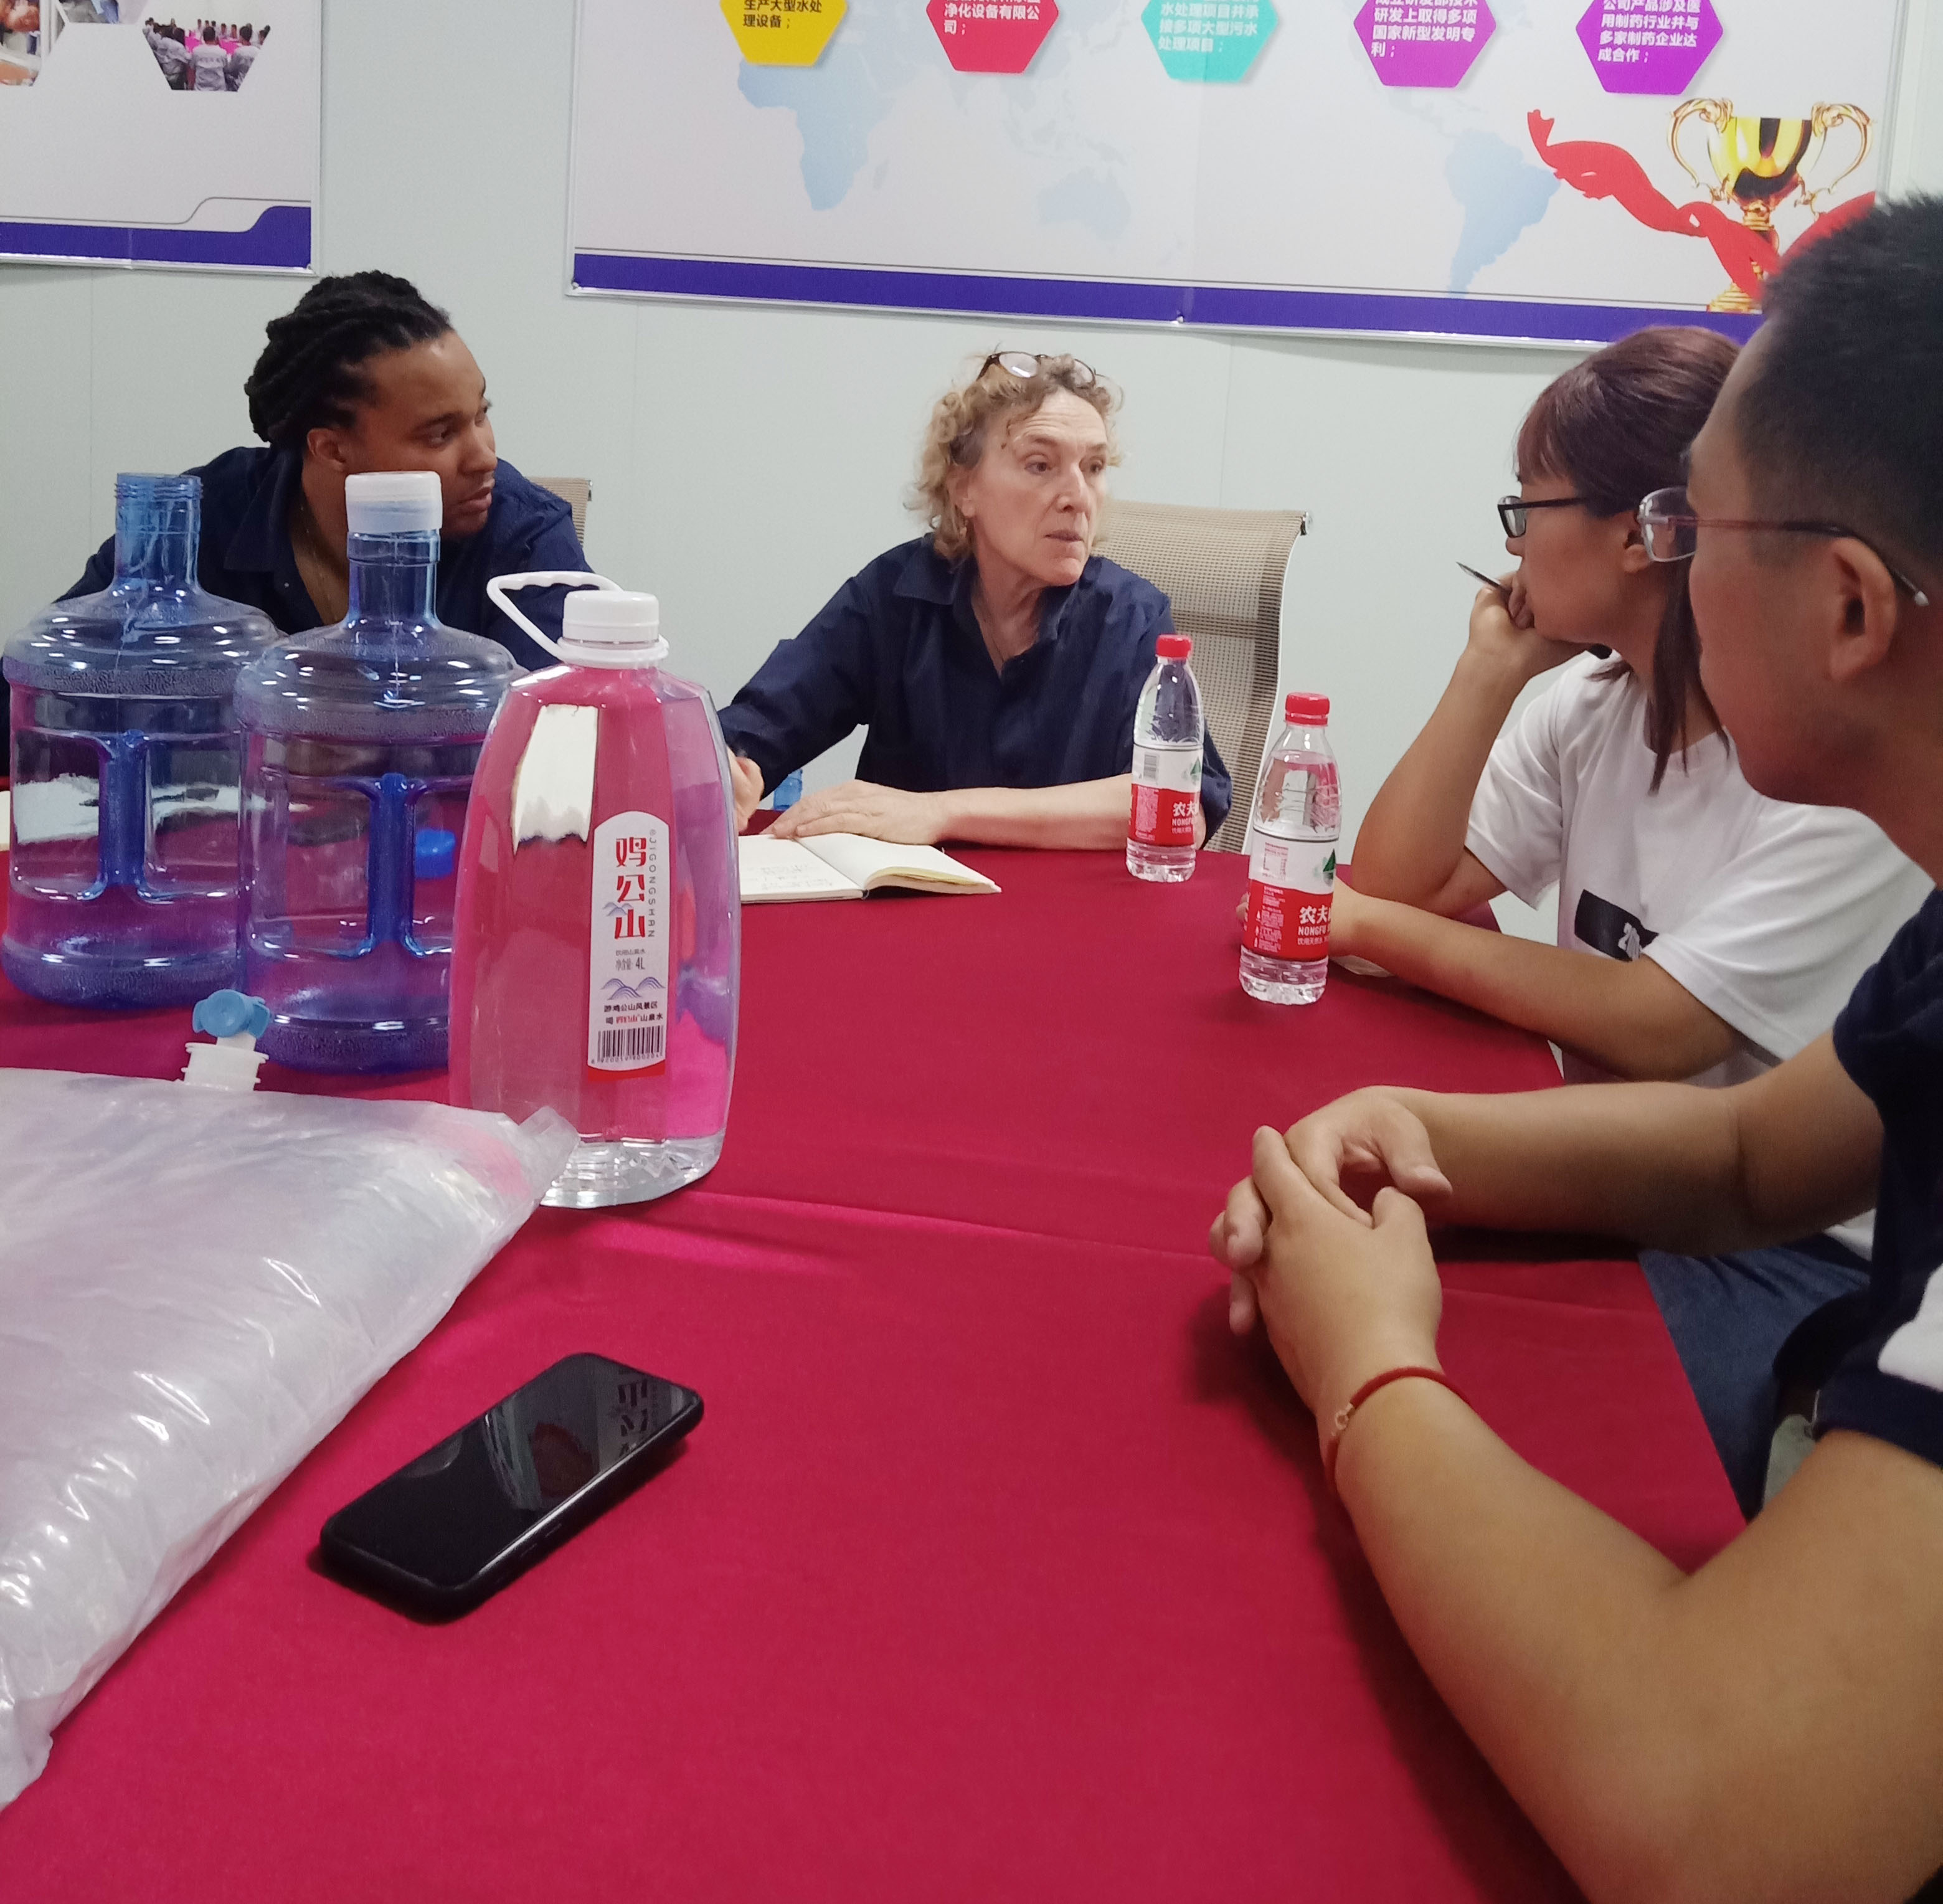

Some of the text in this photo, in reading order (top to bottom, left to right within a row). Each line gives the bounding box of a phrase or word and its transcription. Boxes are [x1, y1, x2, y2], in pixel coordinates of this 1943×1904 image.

[744, 0, 822, 13] 生产大型水处
[943, 2, 1040, 20] 净化设备有限公
[1160, 2, 1259, 18] 水处理项目并承
[1603, 0, 1701, 13] 公司产品涉及医
[1374, 7, 1478, 24] 研发上取得多项
[1600, 13, 1700, 31] 用制药行业并与
[1159, 19, 1257, 36] 接多项大型污水
[1372, 24, 1476, 42] 国家新型发明专
[1599, 29, 1698, 47] 多家制药企业达
[614, 836, 647, 939] 鸡公山
[1298, 925, 1326, 936] NONGFU
[635, 956, 646, 970] 4L
[603, 1001, 658, 1013] 游鸡公山风景区
